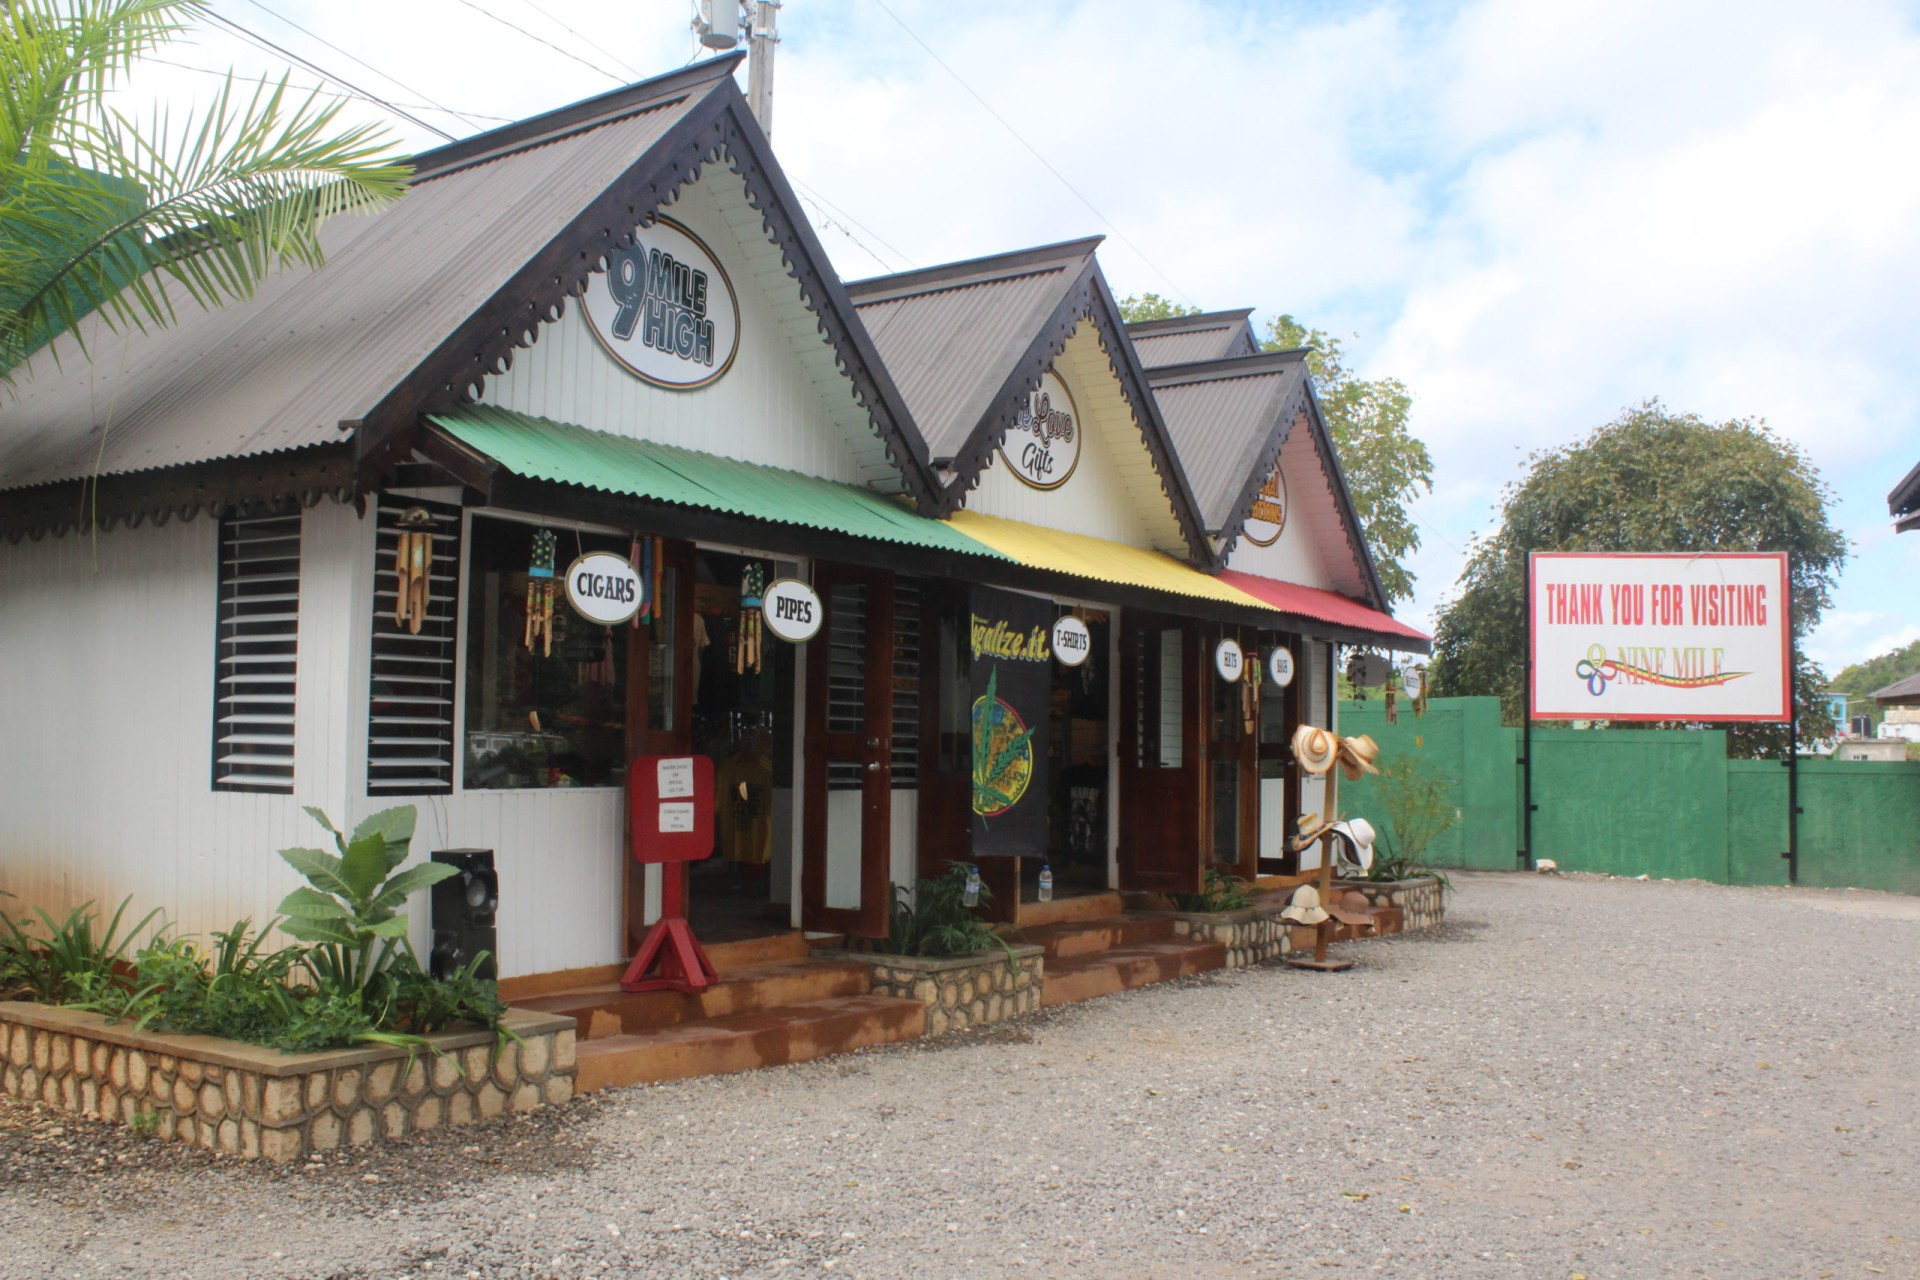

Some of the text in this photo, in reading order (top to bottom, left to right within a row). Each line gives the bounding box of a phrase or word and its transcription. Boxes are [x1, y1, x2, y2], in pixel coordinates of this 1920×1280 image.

[606, 237, 648, 341] 9
[647, 248, 708, 318] MILE
[643, 296, 715, 366] HIGH
[1022, 442, 1054, 480] Gifts
[577, 572, 635, 604] CIGARS
[1546, 583, 1768, 626] THANK YOU FOR VISITING
[775, 595, 812, 624] PIPES
[1056, 629, 1088, 652] T-SHIRTS
[1224, 651, 1237, 669] HATS
[1617, 646, 1725, 686] NINE MILE
